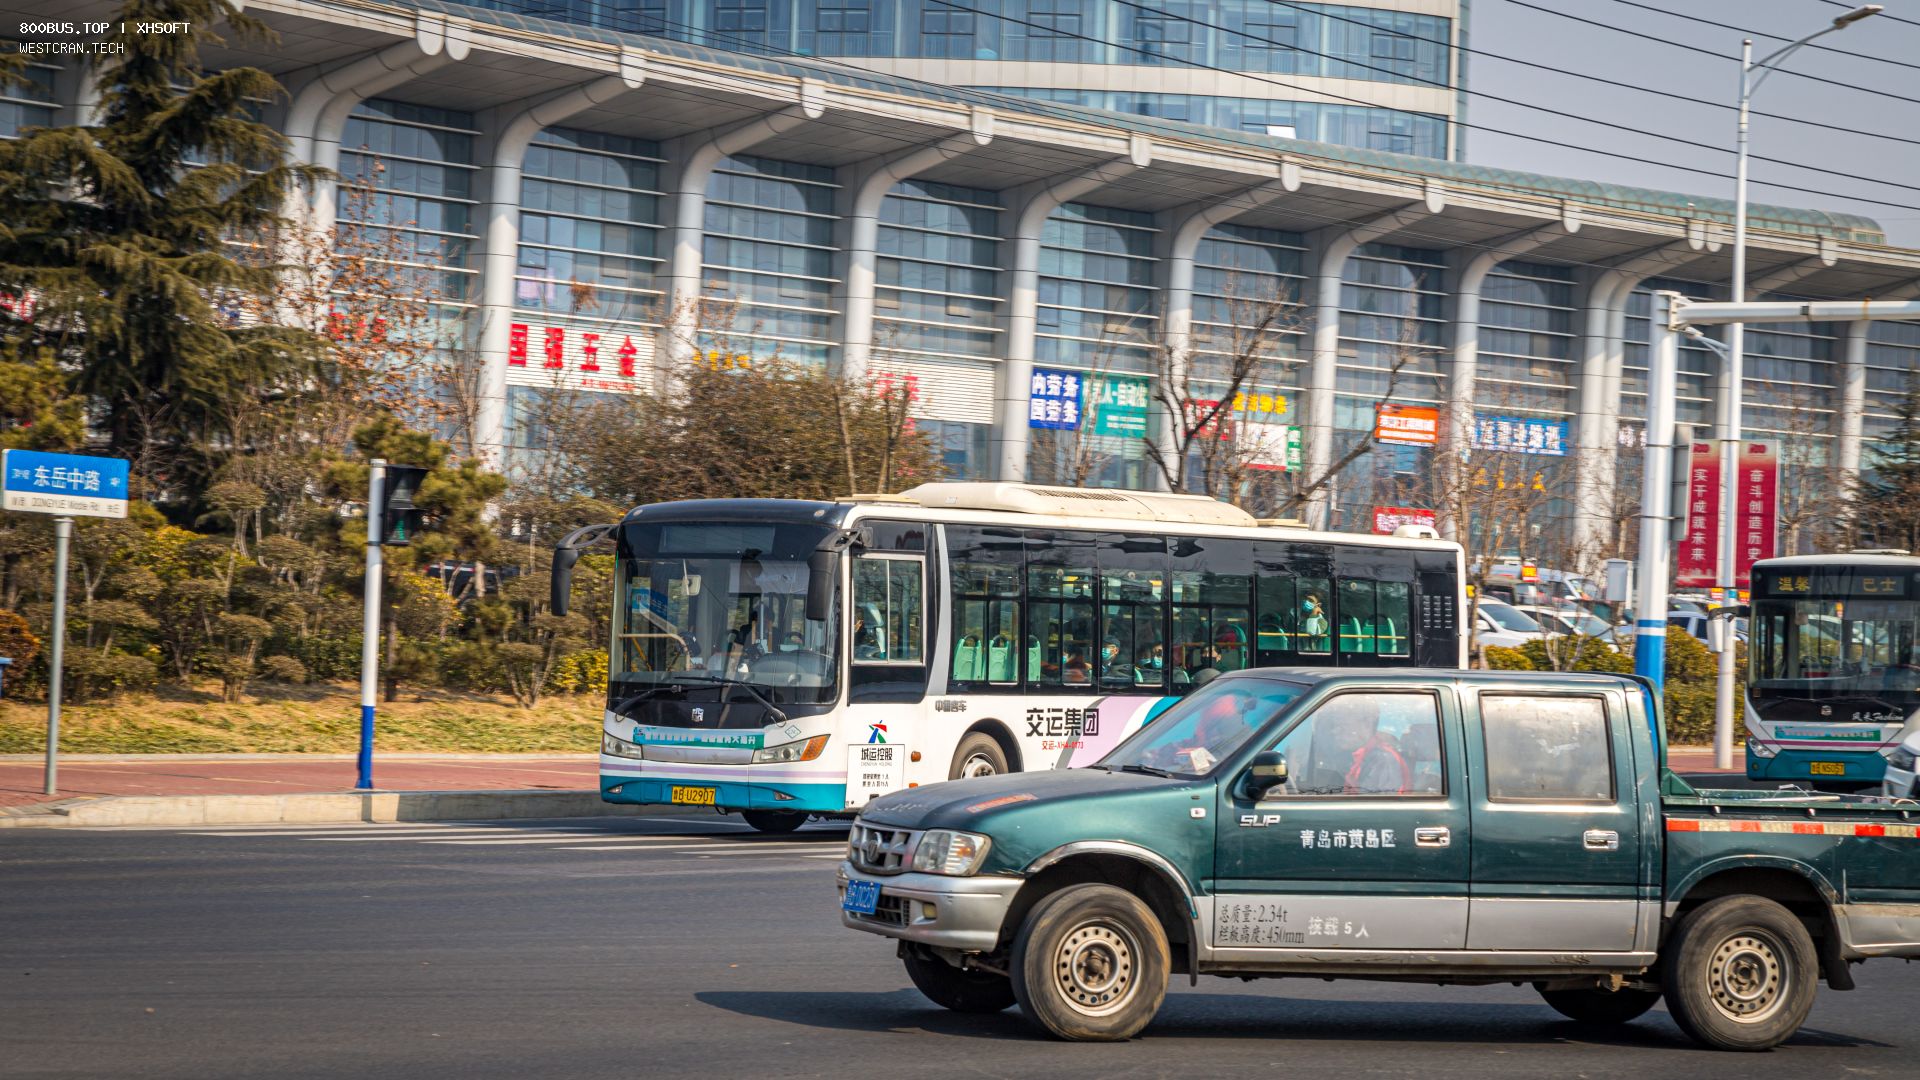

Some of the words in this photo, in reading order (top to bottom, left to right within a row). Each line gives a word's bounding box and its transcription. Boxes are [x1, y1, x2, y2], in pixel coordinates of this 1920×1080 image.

[33, 465, 101, 491] 东岳中路
[1691, 468, 1708, 560] 实干成就未来
[1747, 469, 1765, 560] 奋斗创造历史
[1778, 576, 1811, 592] 温馨
[1863, 577, 1897, 592] 巴士
[1026, 708, 1099, 736] 交运集团
[861, 747, 893, 761] 城运控股
[1240, 815, 1281, 827] SUP
[1300, 829, 1397, 849] 青岛市黄岛区
